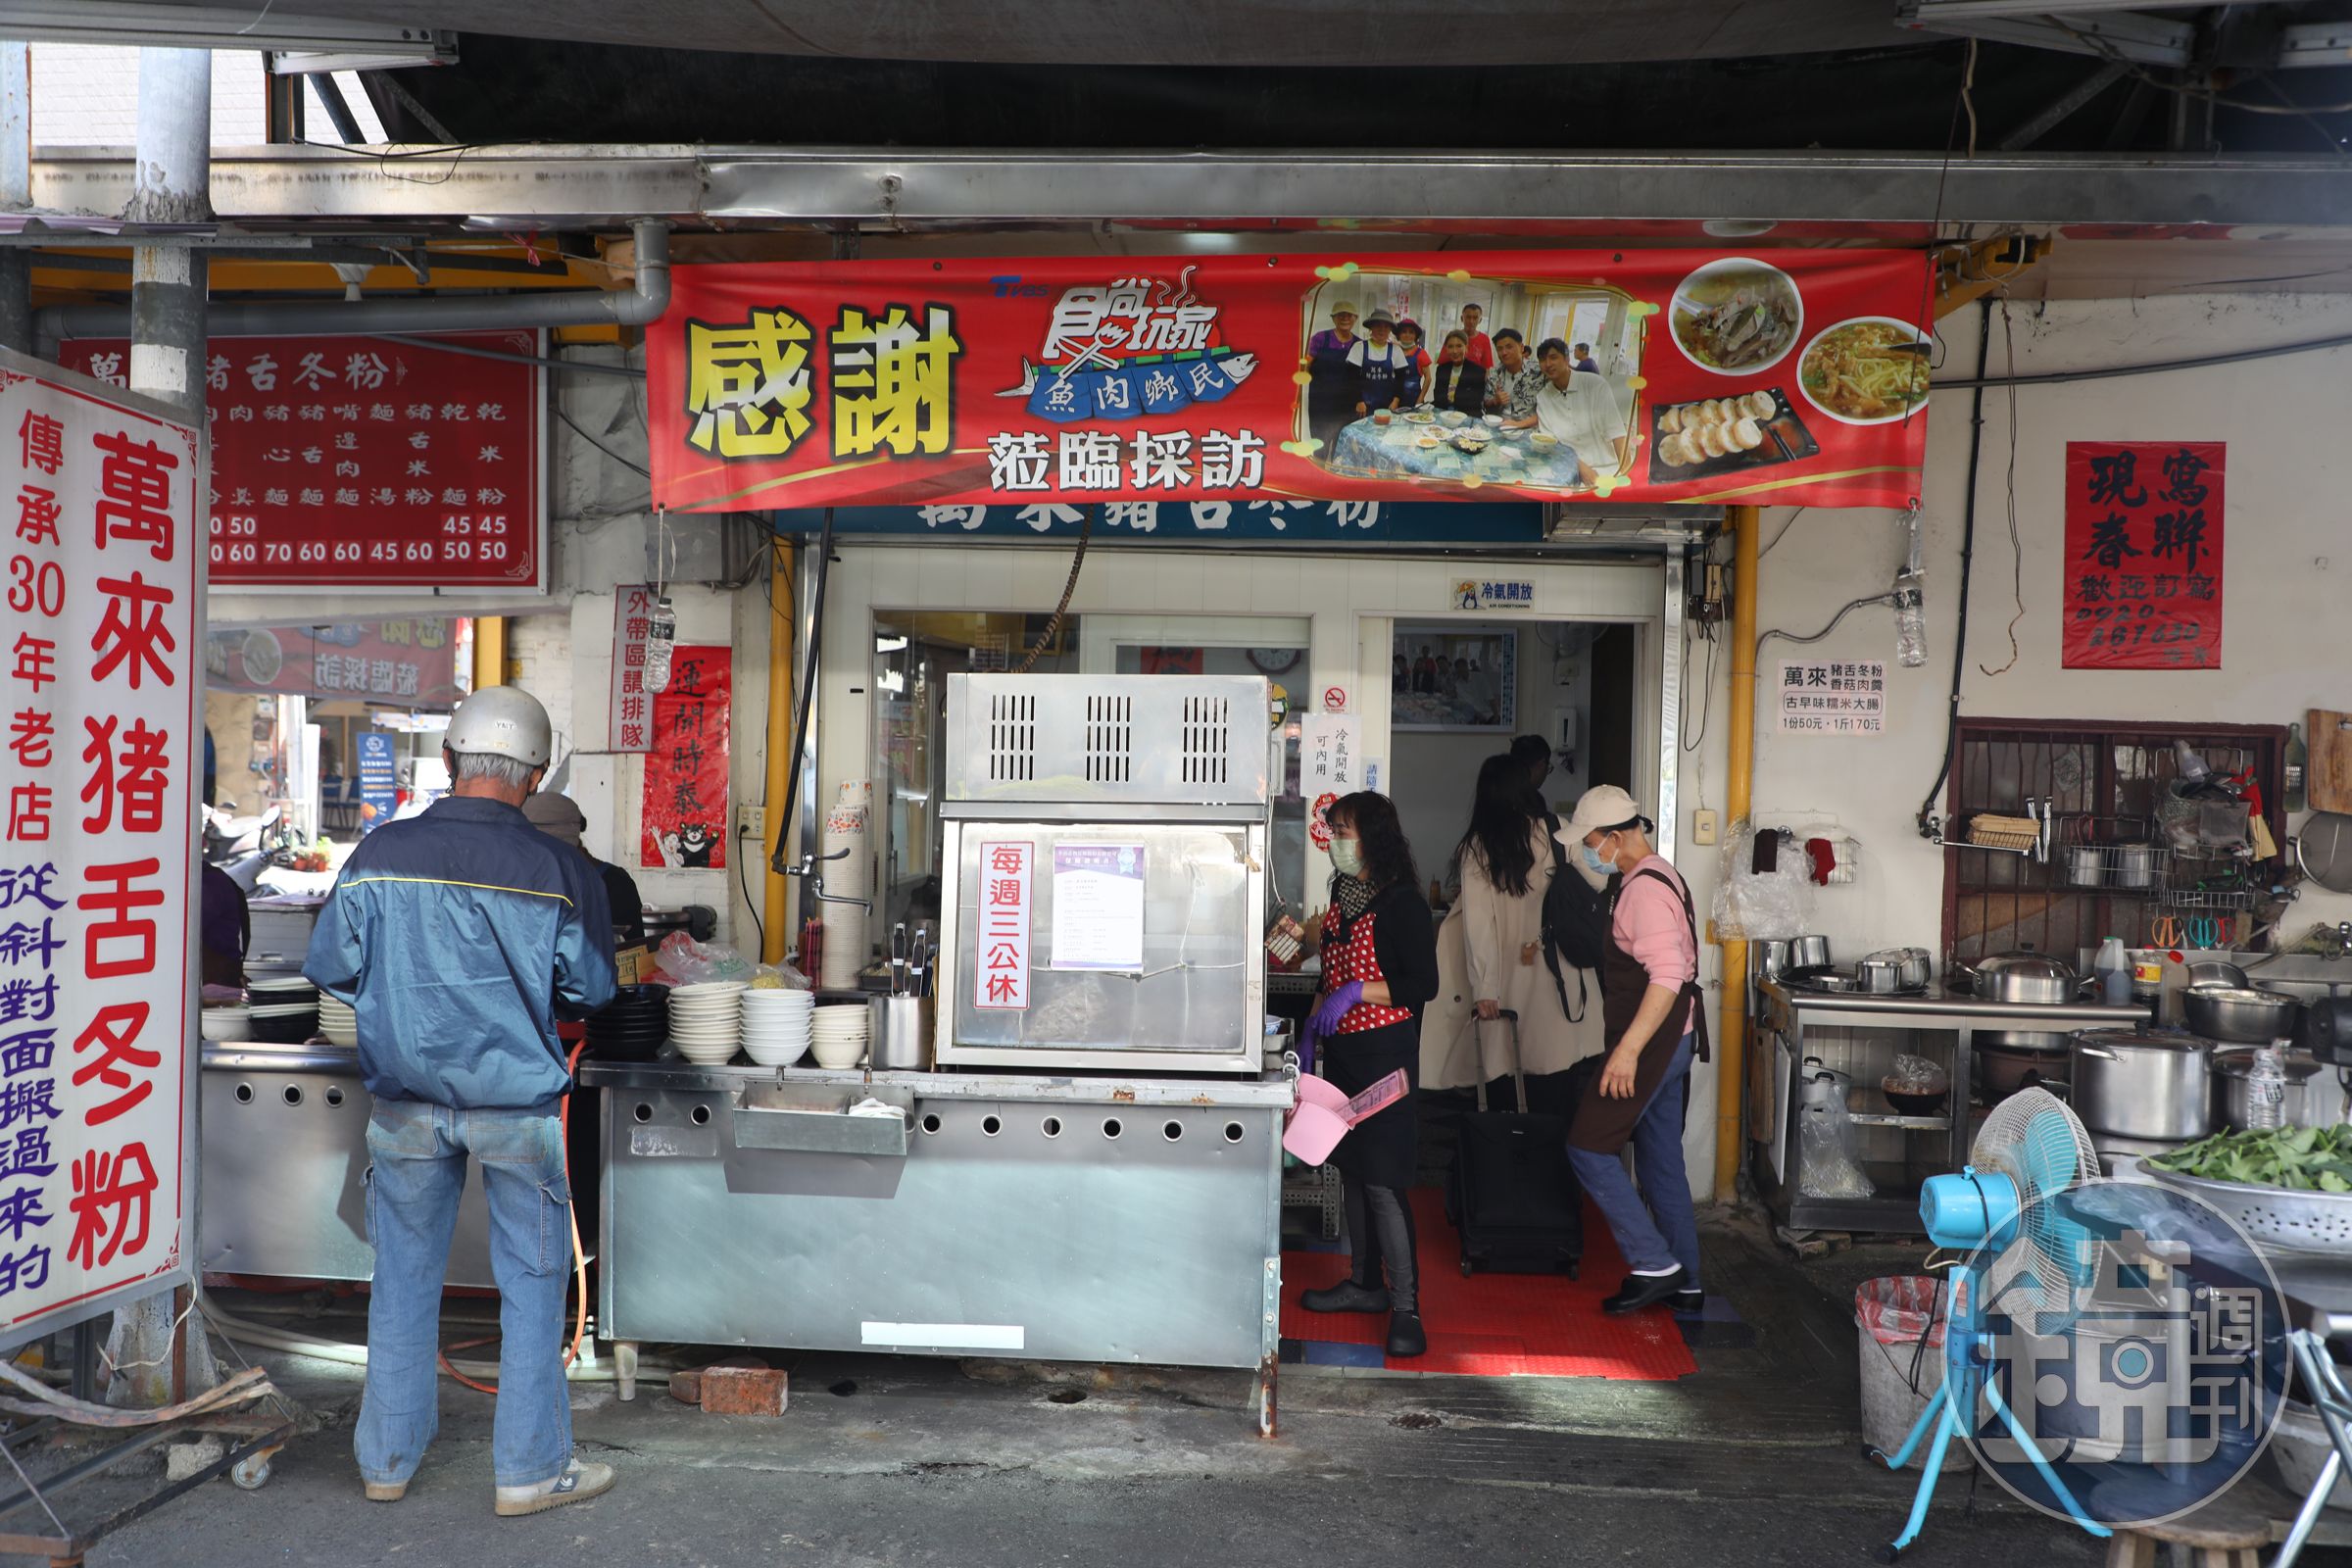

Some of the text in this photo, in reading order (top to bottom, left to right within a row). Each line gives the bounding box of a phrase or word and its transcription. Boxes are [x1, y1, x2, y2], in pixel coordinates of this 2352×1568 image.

[1042, 276, 1218, 361] 食尚玩家
[689, 308, 961, 458] 感謝
[1045, 363, 1224, 414] 魚肉鄉民
[987, 428, 1266, 491] 蒞臨採訪
[229, 516, 256, 535] 50
[443, 516, 470, 534] 45
[479, 516, 507, 534] 45
[229, 544, 256, 562] 60
[265, 544, 292, 562] 70
[299, 543, 326, 561] 60
[334, 543, 361, 561] 60
[370, 543, 398, 561] 45
[405, 543, 433, 561] 60
[443, 541, 470, 560] 50
[479, 541, 507, 560] 50
[2082, 509, 2210, 573] 春聯
[1481, 581, 1533, 601] 冷氣開放
[8, 408, 66, 843] 傳承30年老店
[620, 590, 652, 748] 外帶區請排隊
[1784, 665, 1828, 688] 萬來
[1830, 664, 1883, 677] 豬舌冬粉
[1786, 696, 1880, 710] 古早味糯米大腸
[1315, 735, 1329, 776] 可內用
[1334, 727, 1348, 783] 冷氣開放
[1366, 763, 1378, 791] 請隨
[985, 845, 1023, 1004] 每週三公休
[0, 860, 69, 1297] 從斜對面搬過來的
